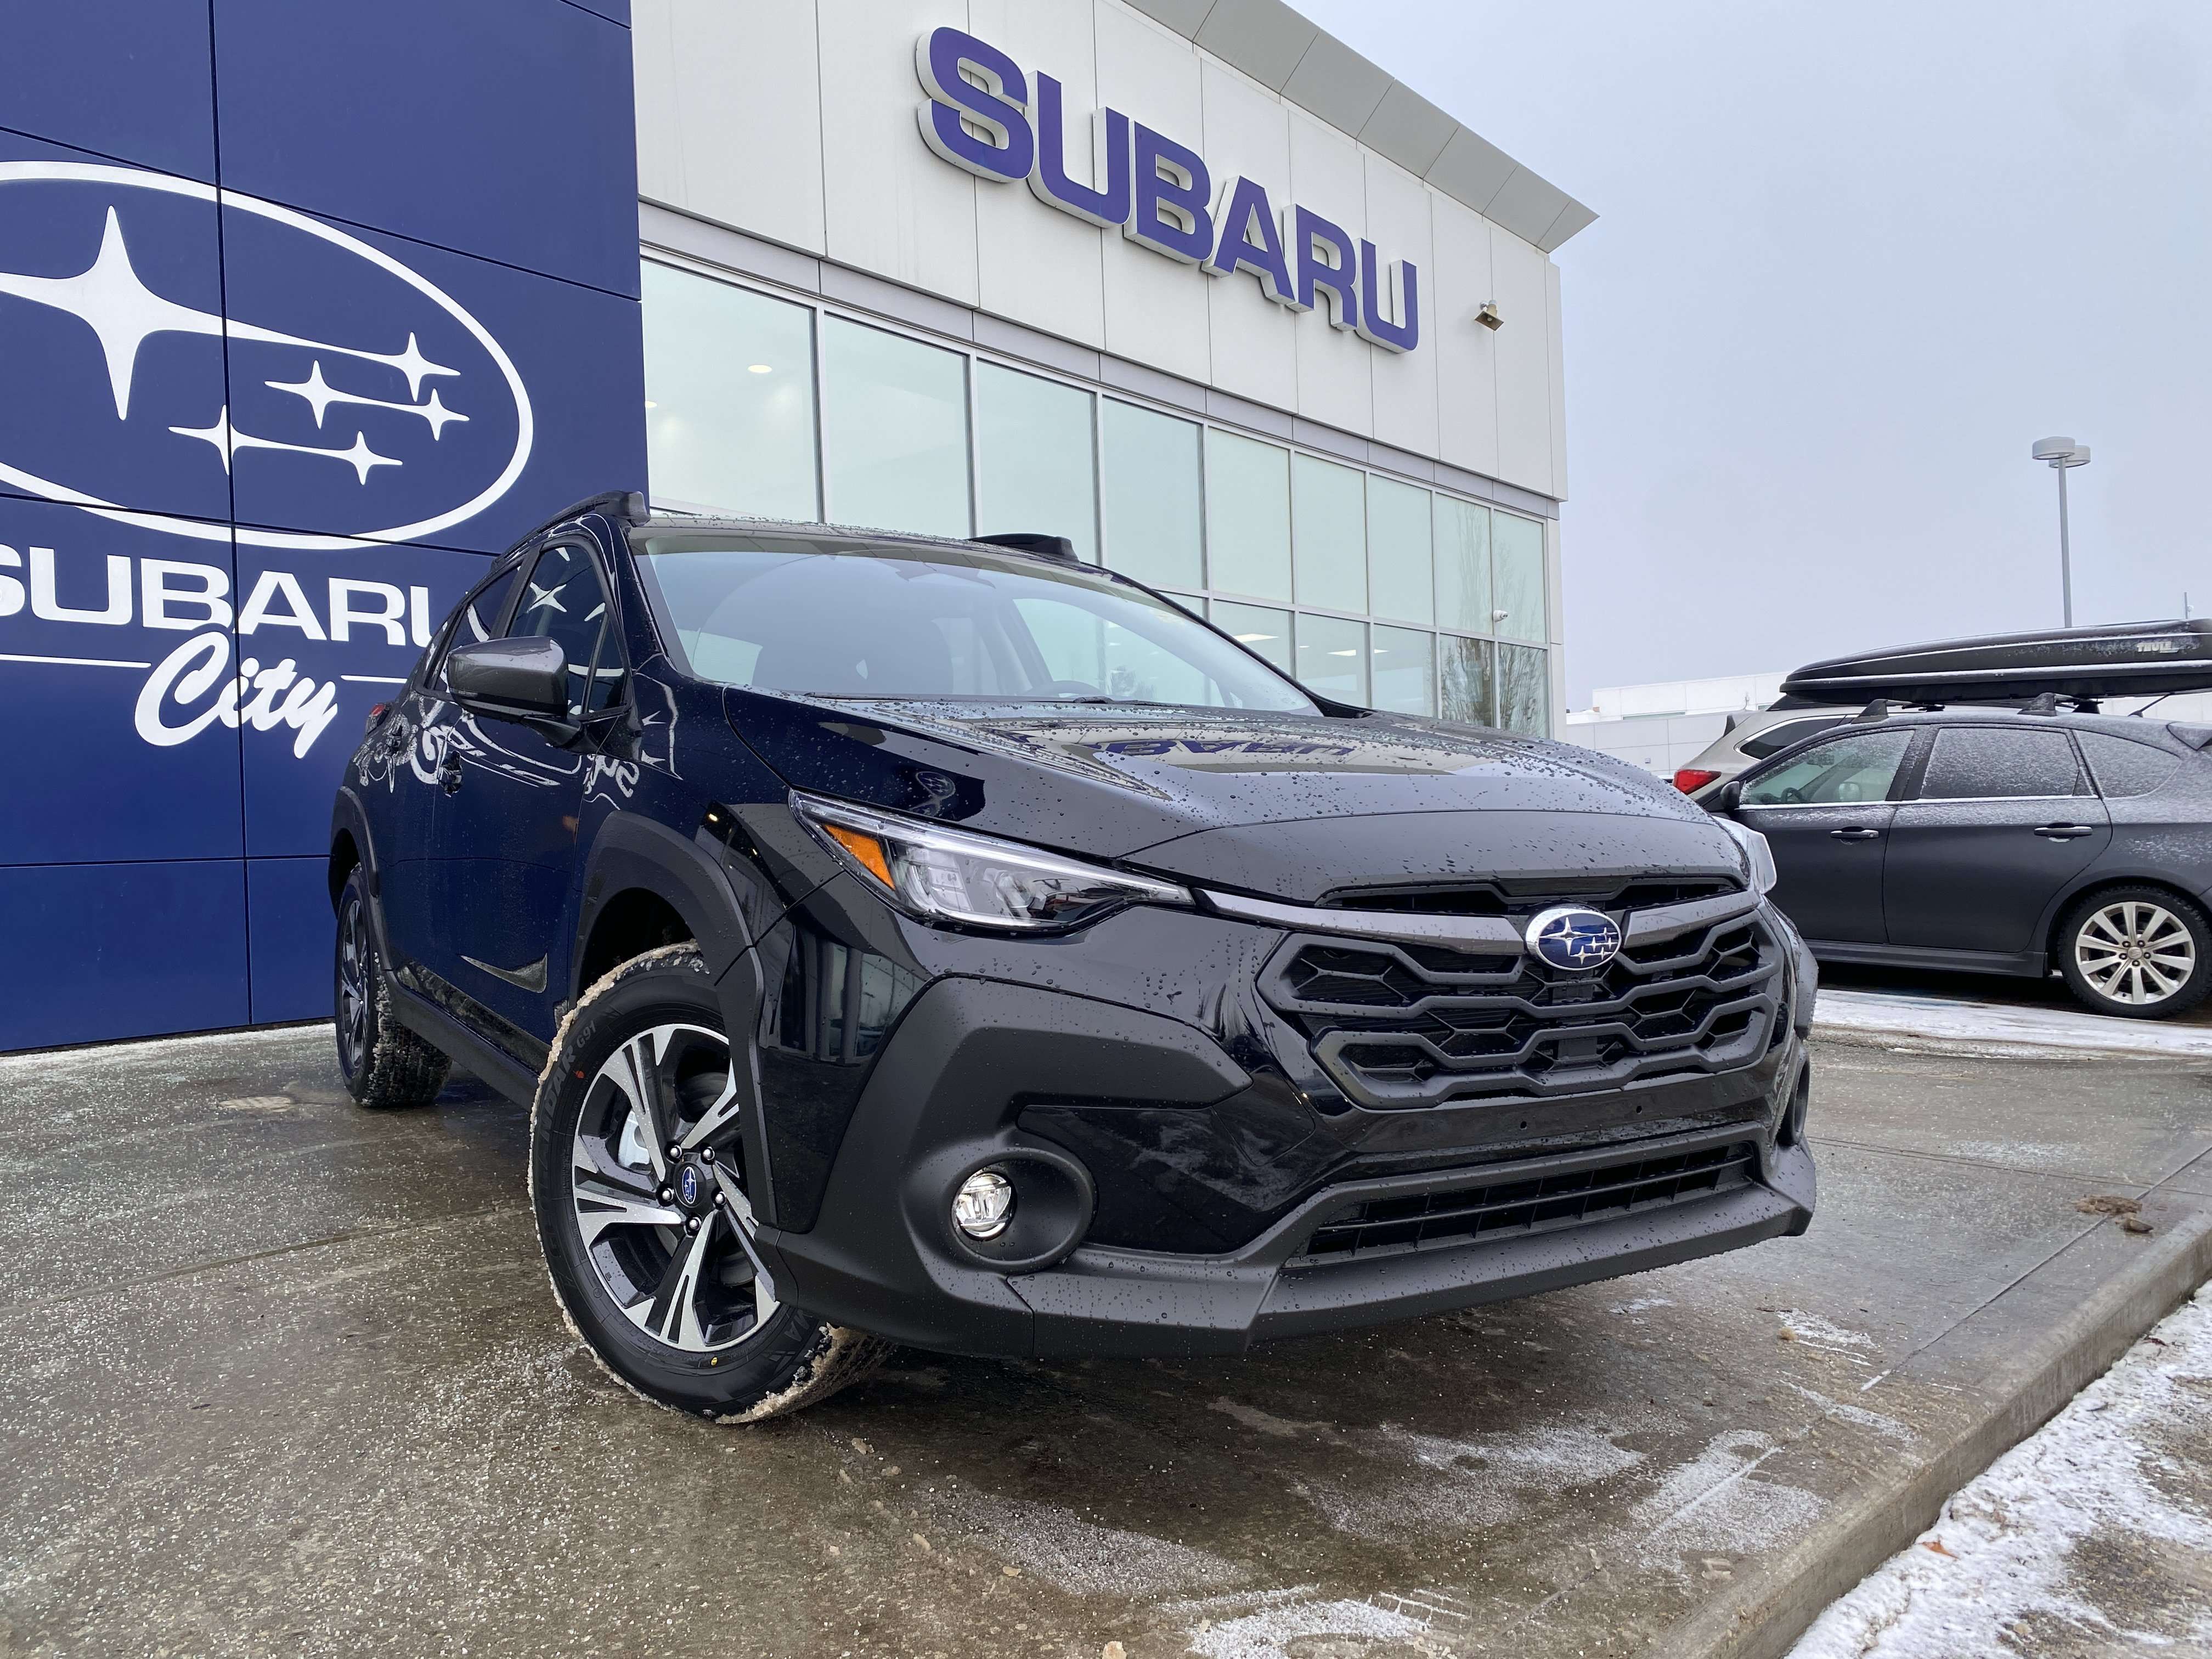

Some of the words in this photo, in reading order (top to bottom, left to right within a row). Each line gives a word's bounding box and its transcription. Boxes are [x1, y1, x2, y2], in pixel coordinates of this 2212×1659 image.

[916, 26, 1417, 353] SUBARU
[0, 543, 436, 648] UBAR
[2137, 641, 2177, 653] THULE
[134, 631, 337, 759] City
[576, 1020, 596, 1048] G91
